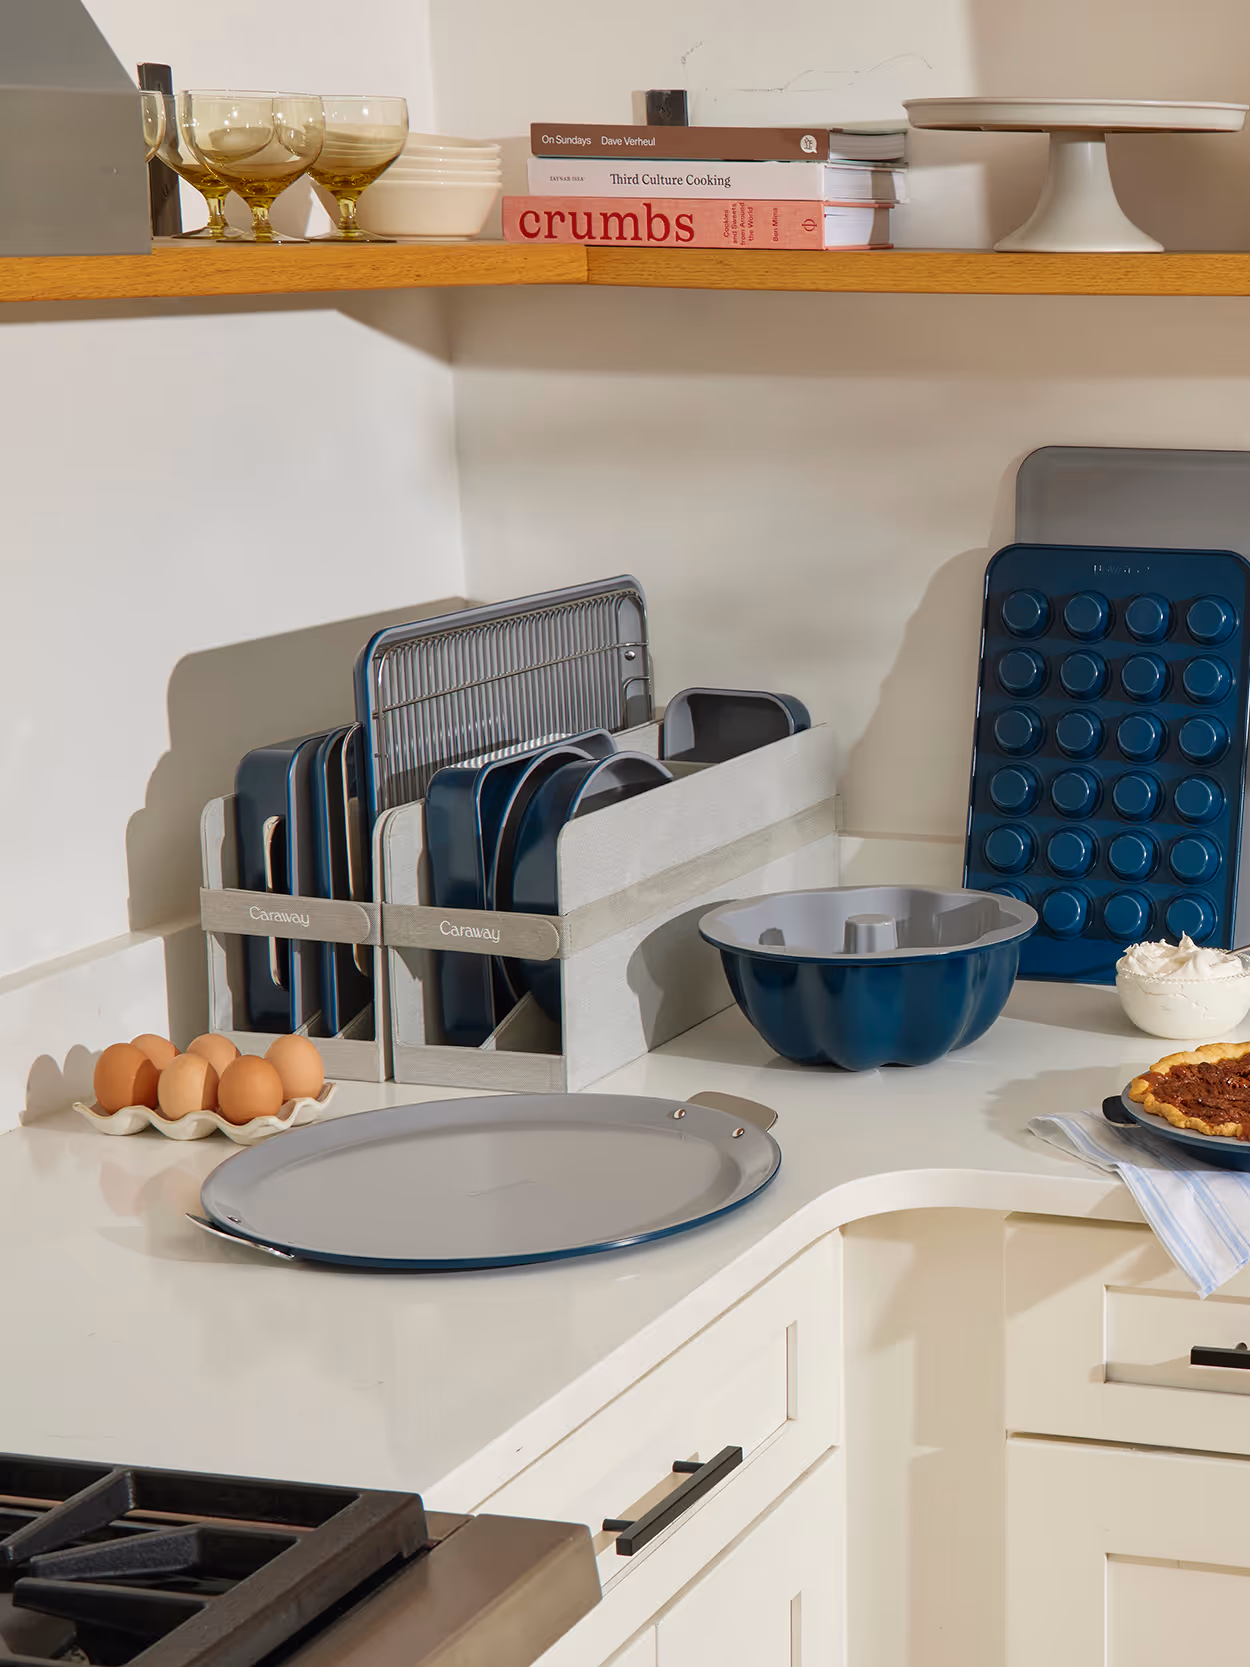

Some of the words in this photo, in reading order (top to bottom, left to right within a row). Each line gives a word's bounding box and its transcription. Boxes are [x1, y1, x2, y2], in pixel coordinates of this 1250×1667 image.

[541, 134, 555, 144] On
[555, 134, 592, 147] Sundays
[601, 135, 622, 146] Dave
[623, 135, 656, 147] Verheul
[610, 173, 640, 185] Third
[641, 173, 684, 186] Culture
[685, 174, 731, 189] Cooking
[518, 202, 695, 242] crumbs
[249, 905, 310, 928] Caraway
[439, 920, 501, 943] Caraway
